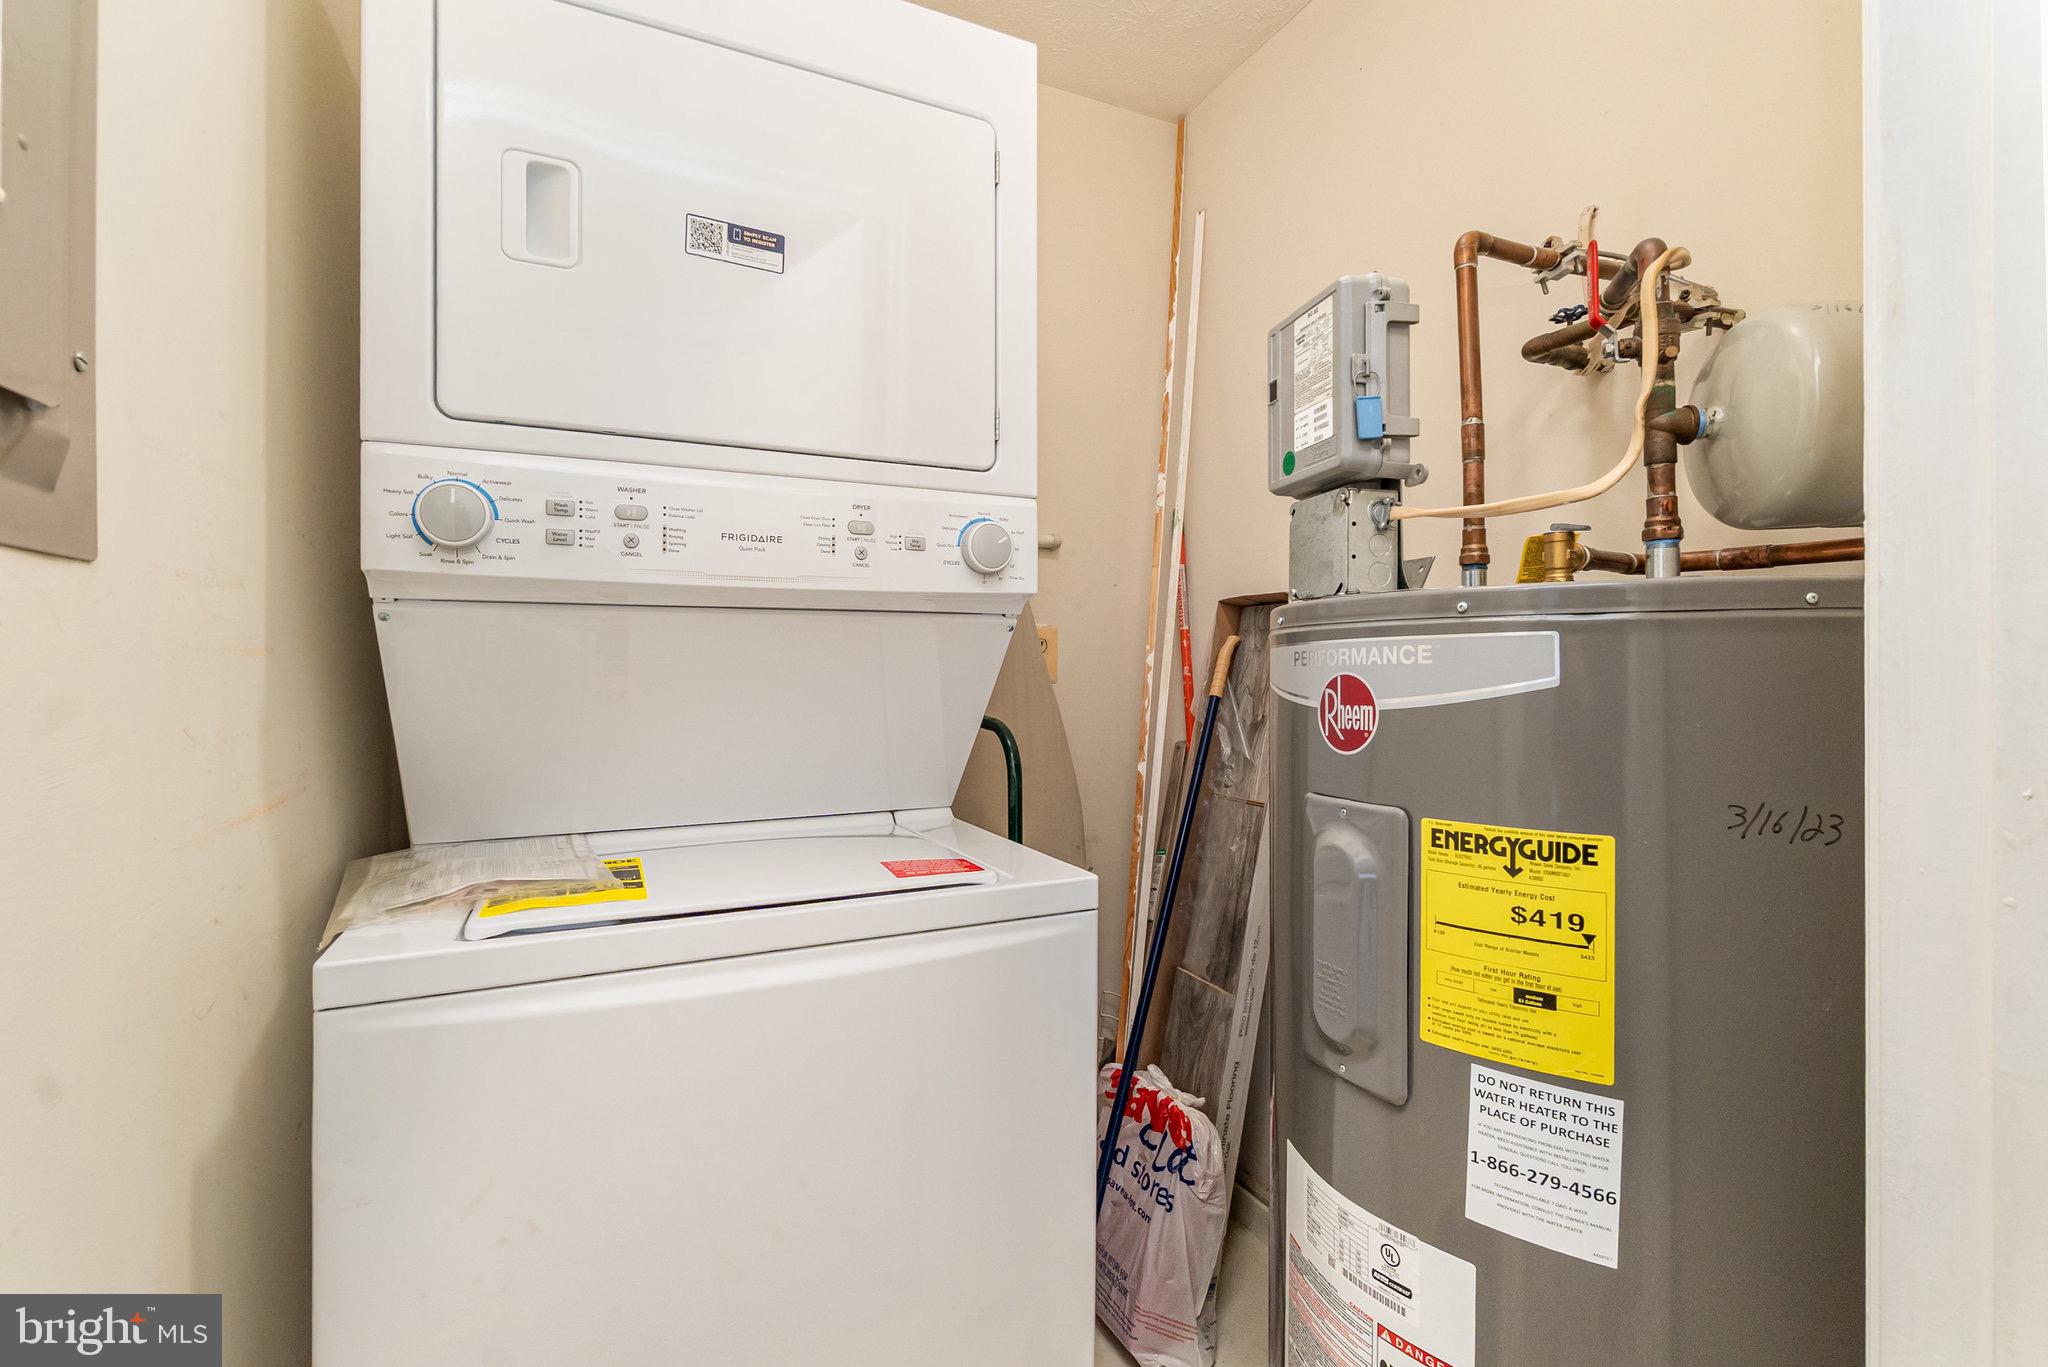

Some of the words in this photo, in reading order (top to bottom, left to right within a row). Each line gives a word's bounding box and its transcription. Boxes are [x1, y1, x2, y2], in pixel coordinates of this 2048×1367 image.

[762, 234, 777, 243] SCAN
[418, 473, 433, 481] Bulky
[617, 486, 647, 494] WASHER
[386, 532, 401, 540] Light
[721, 532, 784, 544] FRIGIDAIRE
[1293, 644, 1433, 668] PERFORMANCE
[1324, 675, 1374, 740] Rheem
[1727, 802, 1844, 846] 3/16/23
[1431, 828, 1598, 867] ENERGYGUIDE
[1458, 882, 1489, 894] Estimated
[1491, 886, 1512, 898] Yearly
[1514, 890, 1537, 902] Energy
[1540, 892, 1555, 902] Cost
[1510, 905, 1585, 932] $419
[1474, 940, 1486, 948] Cost
[1486, 943, 1499, 951] Range
[1505, 946, 1522, 954] Similar
[1522, 949, 1540, 958] Models
[1484, 964, 1498, 975] First
[1500, 968, 1517, 978] Hour
[1519, 972, 1542, 983] Rating
[1226, 1062, 1240, 1110] Flooring
[1478, 1073, 1496, 1086] DO
[1500, 1080, 1526, 1094] NOT
[1529, 1088, 1582, 1110] RETURN
[1586, 1101, 1616, 1117] THIS
[1474, 1087, 1516, 1108] WATER
[1519, 1099, 1568, 1122] HEATER
[1571, 1114, 1589, 1127] TO
[1592, 1119, 1619, 1134] THE
[1479, 1104, 1516, 1124] PLACE
[1520, 1117, 1538, 1129] OF
[1540, 1122, 1611, 1149] PURCHASE
[1131, 1160, 1175, 1213] stores
[1470, 1150, 1617, 1206] 1-866-279-4566
[1349, 1301, 1374, 1322] CAUTION
